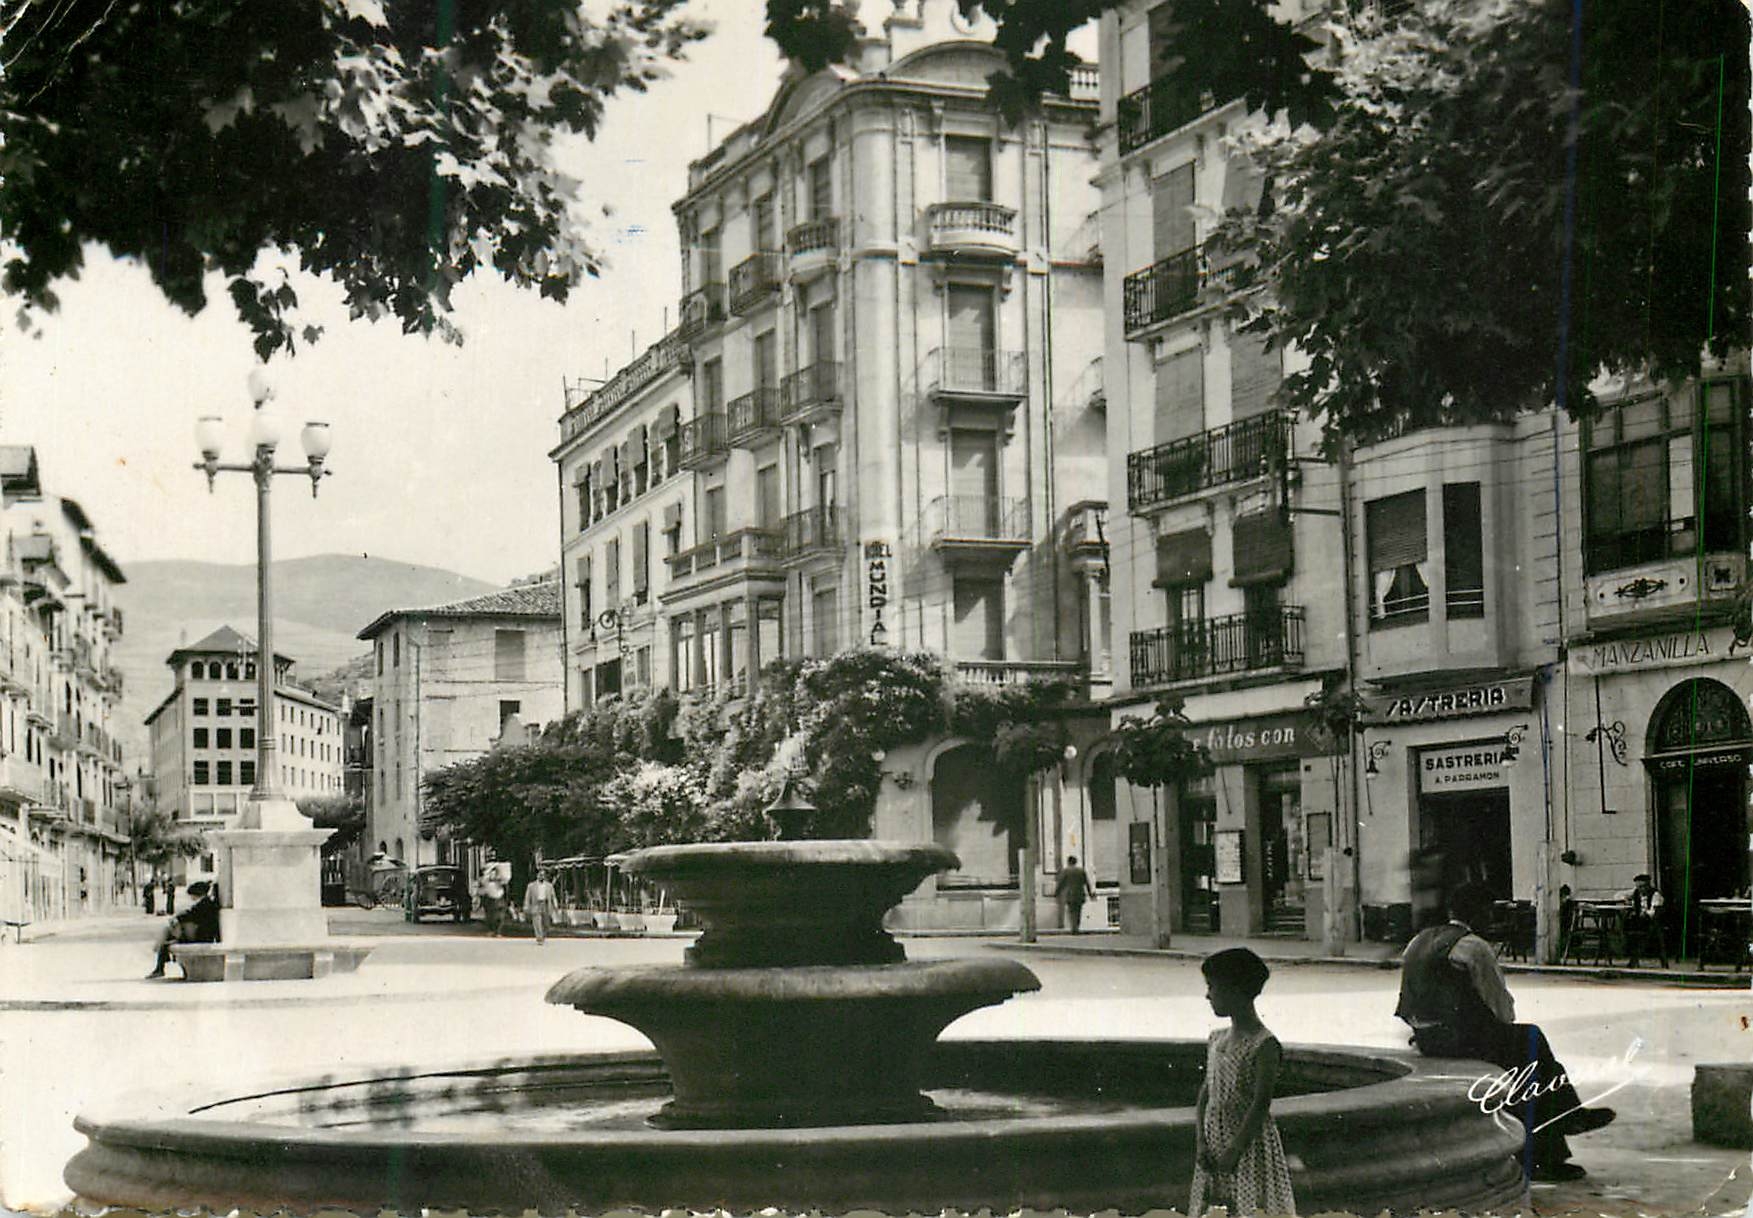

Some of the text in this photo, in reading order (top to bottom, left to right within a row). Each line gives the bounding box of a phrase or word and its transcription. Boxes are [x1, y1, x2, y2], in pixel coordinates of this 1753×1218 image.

[869, 560, 888, 646] MUNDIAL
[1594, 633, 1710, 667] MANZANILLA
[1386, 687, 1506, 717] SASTRERIA
[1260, 726, 1295, 745] con
[1425, 751, 1510, 771] SASTRERIA
